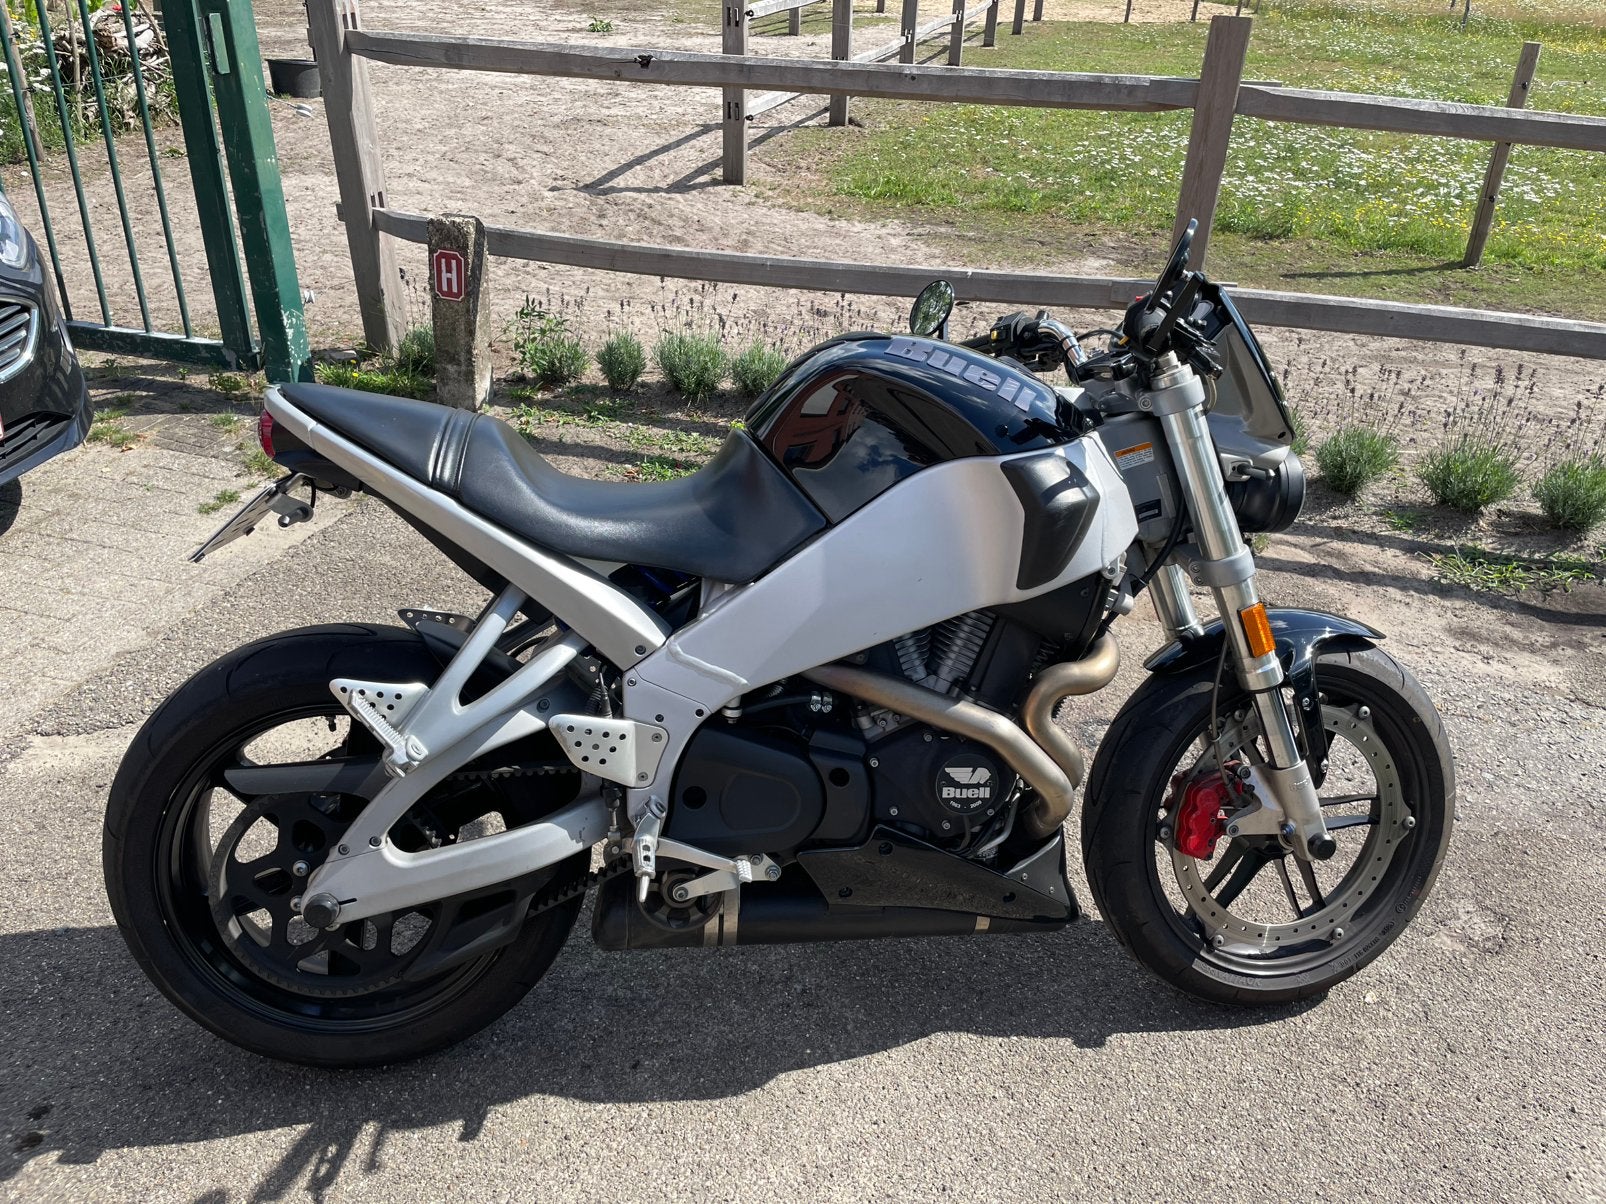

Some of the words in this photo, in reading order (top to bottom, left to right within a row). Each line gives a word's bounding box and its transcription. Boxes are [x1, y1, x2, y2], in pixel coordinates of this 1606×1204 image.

[441, 258, 458, 293] H
[884, 336, 1036, 412] Buell
[942, 787, 990, 798] Buell
